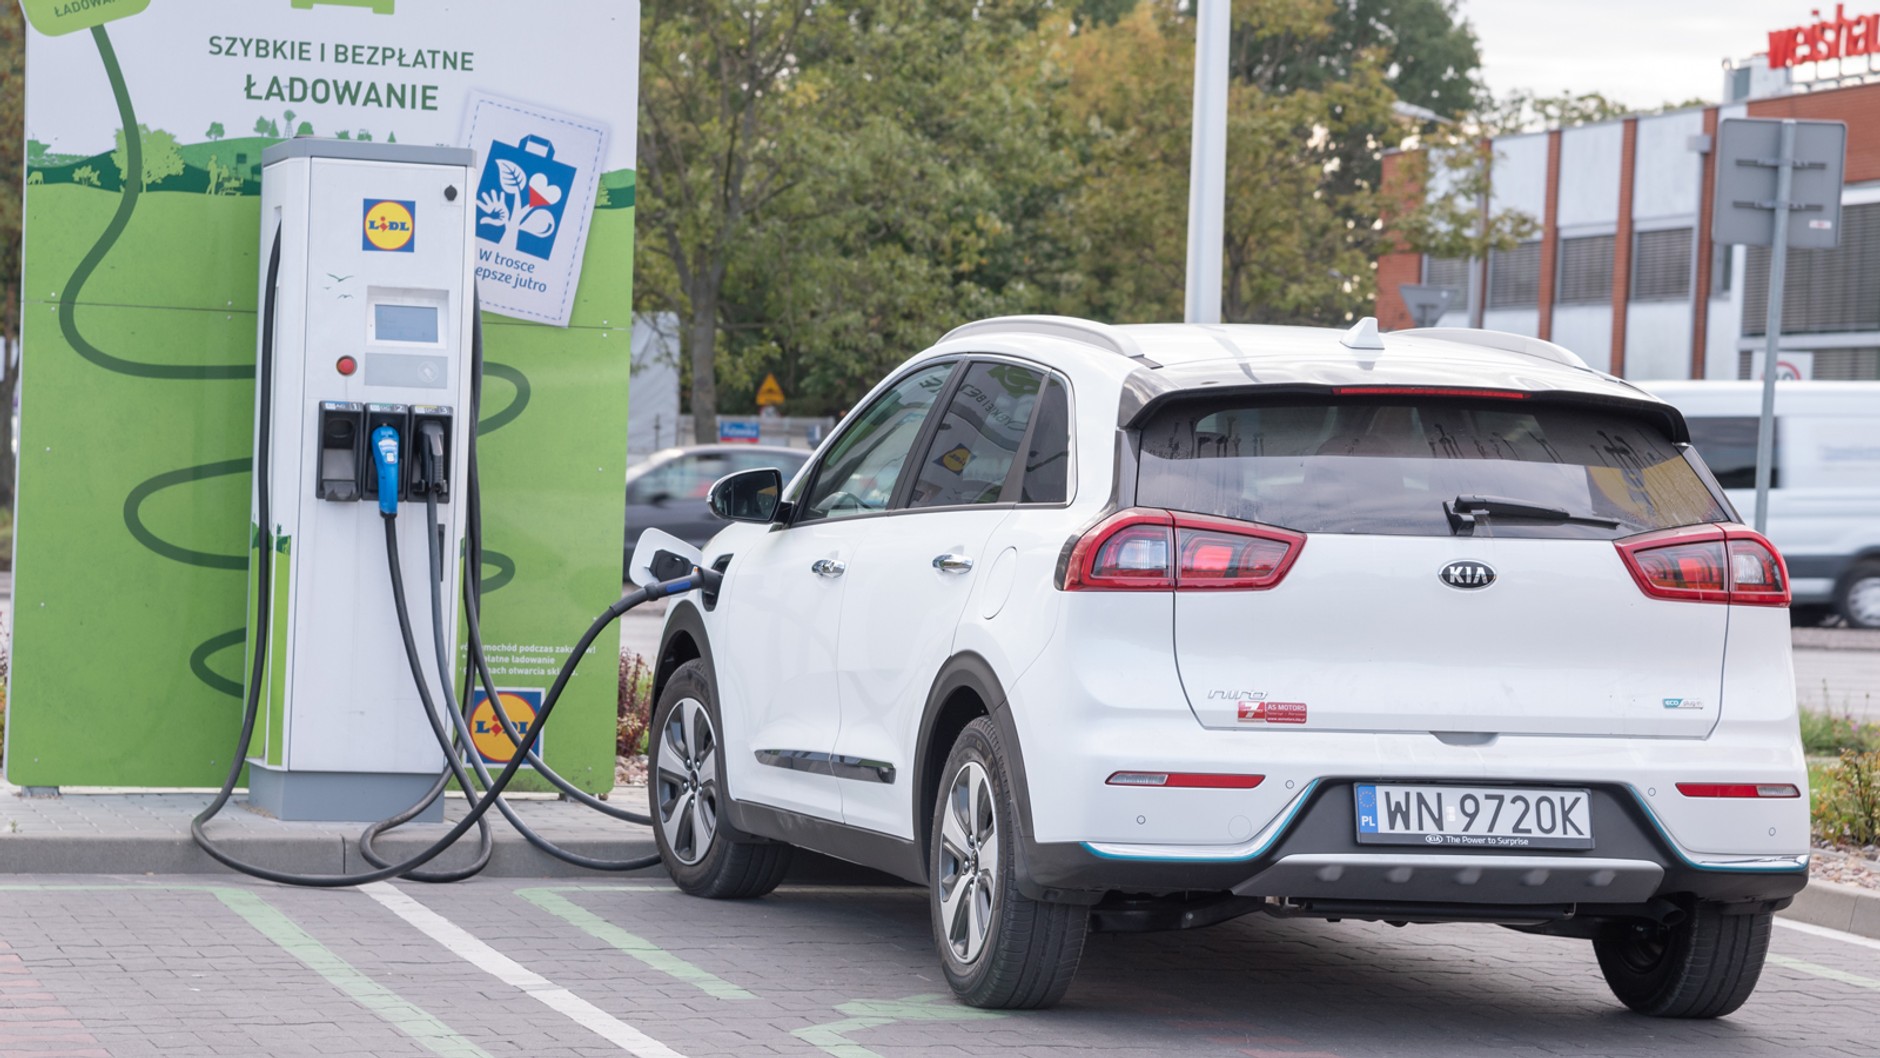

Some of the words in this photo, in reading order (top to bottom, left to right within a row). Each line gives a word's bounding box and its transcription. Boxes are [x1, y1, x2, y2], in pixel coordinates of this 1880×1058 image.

[208, 35, 312, 62] SZYBKIE
[319, 43, 326, 63] I
[333, 44, 475, 72] BEZPŁATNE
[244, 74, 439, 111] ŁADOWANIE
[479, 248, 492, 261] W
[494, 252, 535, 273] trosce
[475, 267, 513, 285] epsze
[512, 273, 547, 293] jutro
[1449, 566, 1488, 584] KIA
[519, 645, 553, 654] podczas
[555, 645, 596, 654] zakuw!
[1278, 704, 1306, 712] MOTORS
[1361, 816, 1375, 827] PL
[1384, 791, 1445, 832] WN
[1459, 793, 1585, 836] 9720K
[1446, 836, 1460, 844] The
[1462, 836, 1486, 845] Power
[1498, 837, 1529, 847] Surprise
